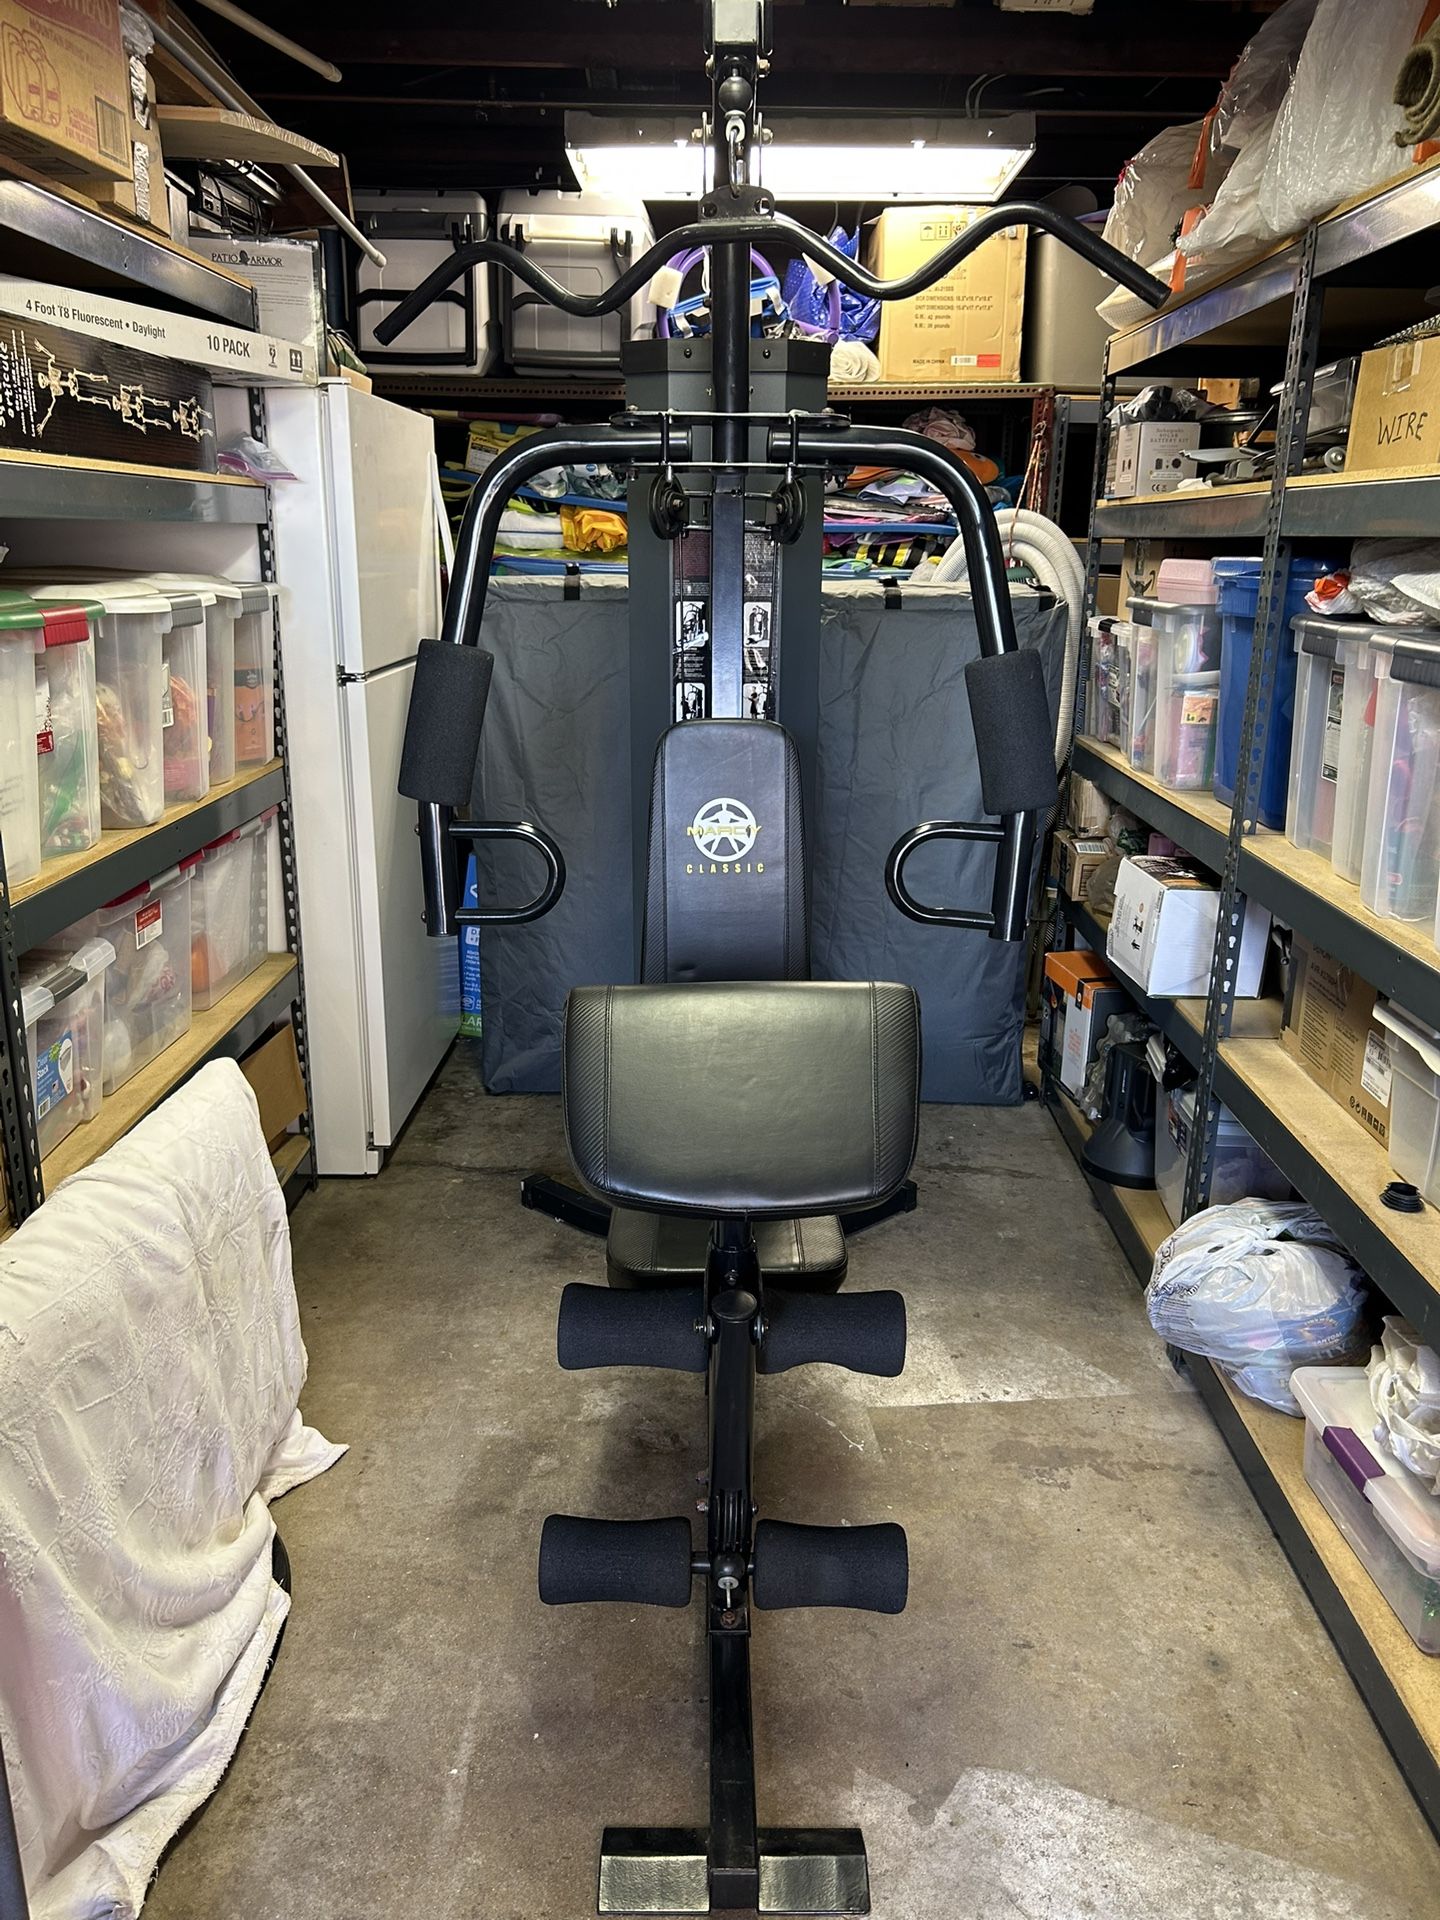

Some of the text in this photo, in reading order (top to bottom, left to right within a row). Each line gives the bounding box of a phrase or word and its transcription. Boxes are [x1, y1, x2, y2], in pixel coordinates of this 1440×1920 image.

[211, 252, 284, 266] PATIO ARMOR
[25, 299, 166, 339] 4 Foot T8 Fluorescent Daylight
[206, 334, 251, 358] 10 PACK
[1377, 411, 1428, 446] WIRE
[686, 825, 763, 836] MARCY
[686, 863, 764, 874] CLASSIC
